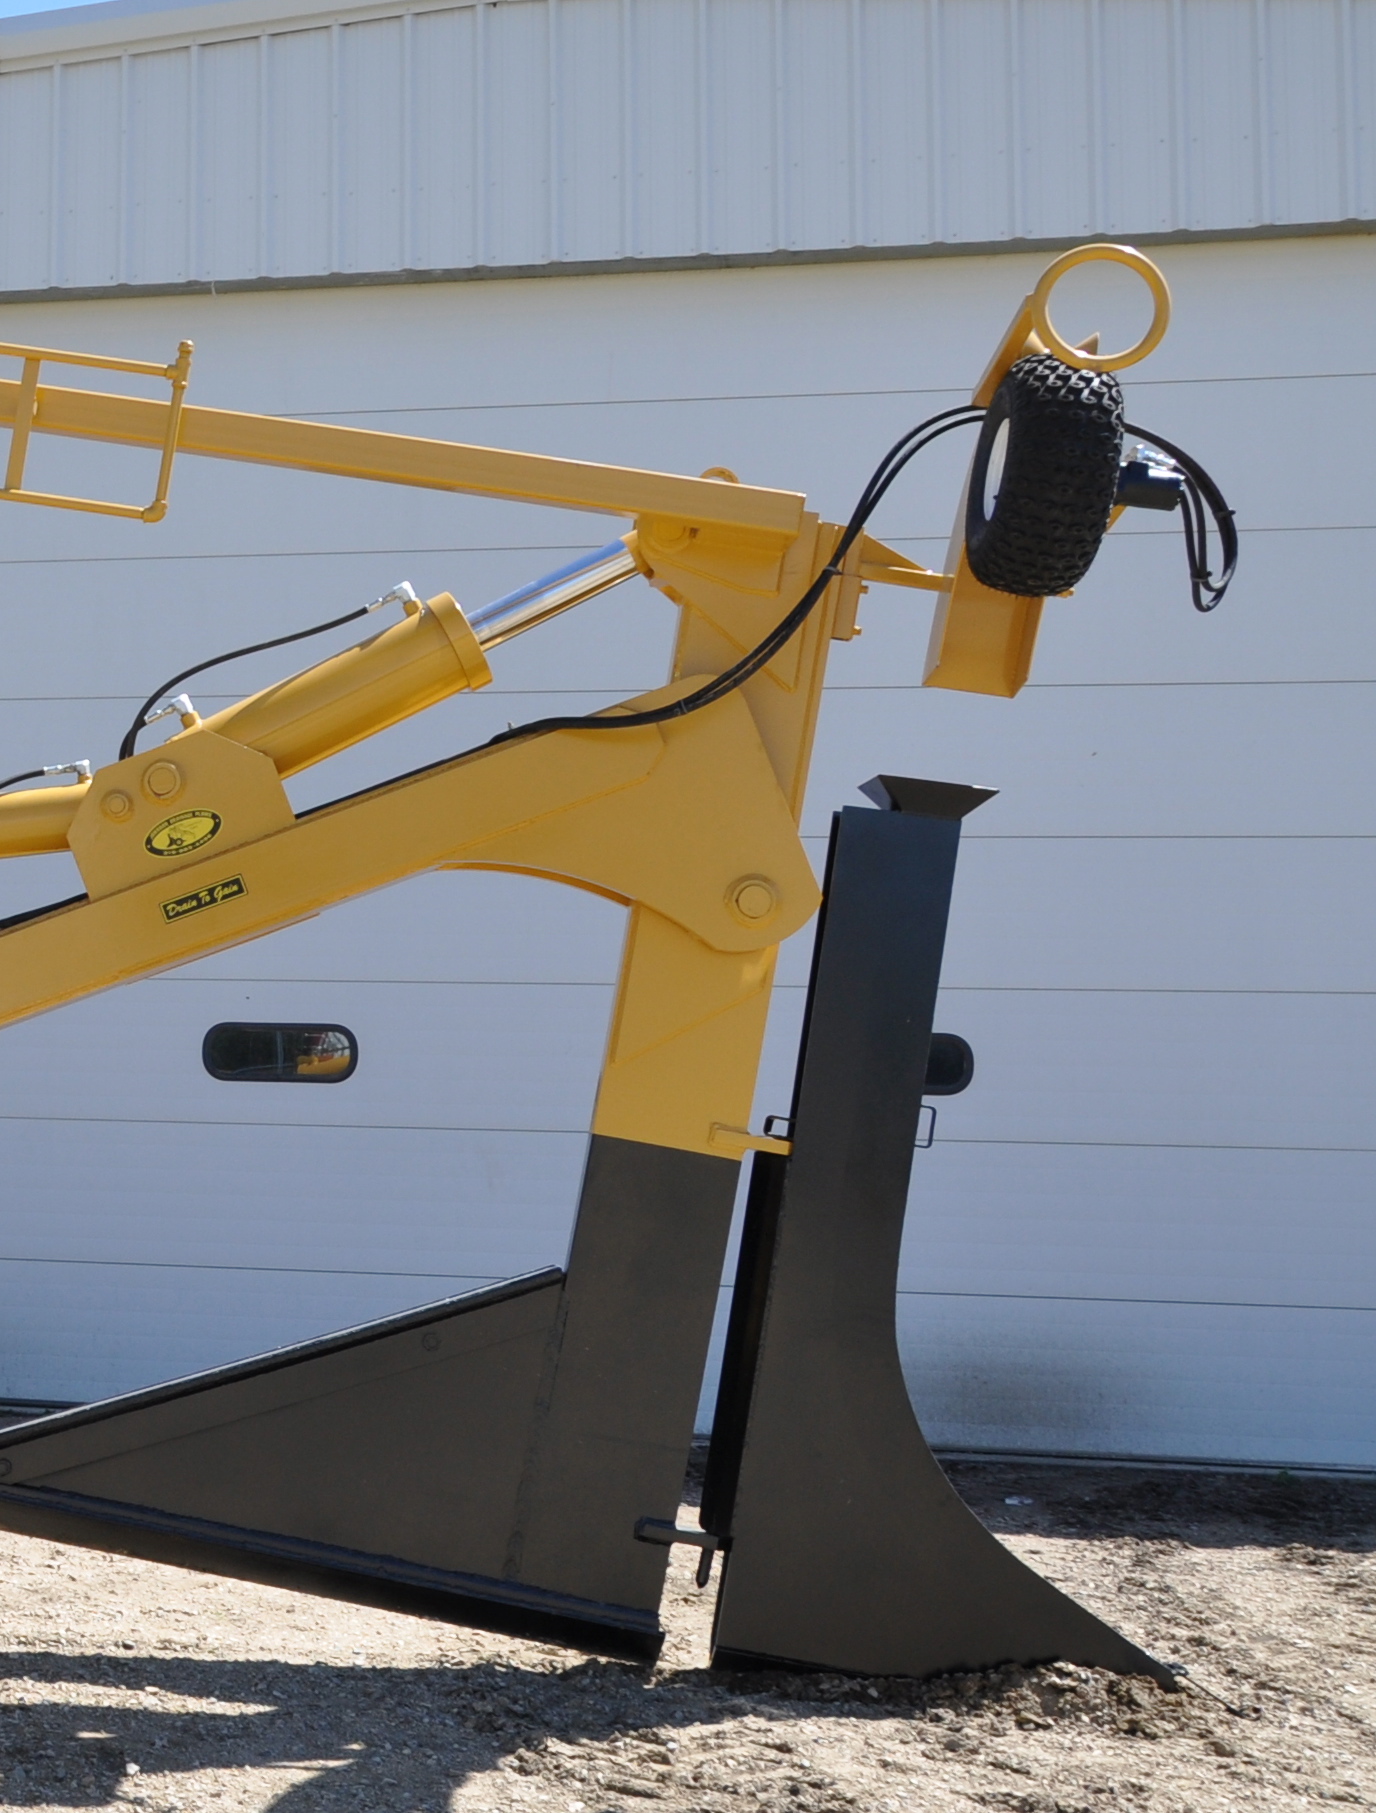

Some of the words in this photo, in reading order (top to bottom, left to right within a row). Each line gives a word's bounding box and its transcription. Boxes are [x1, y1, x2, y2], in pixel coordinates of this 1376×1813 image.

[166, 899, 198, 917] Drain
[198, 891, 211, 905] To
[214, 885, 239, 903] Gain
